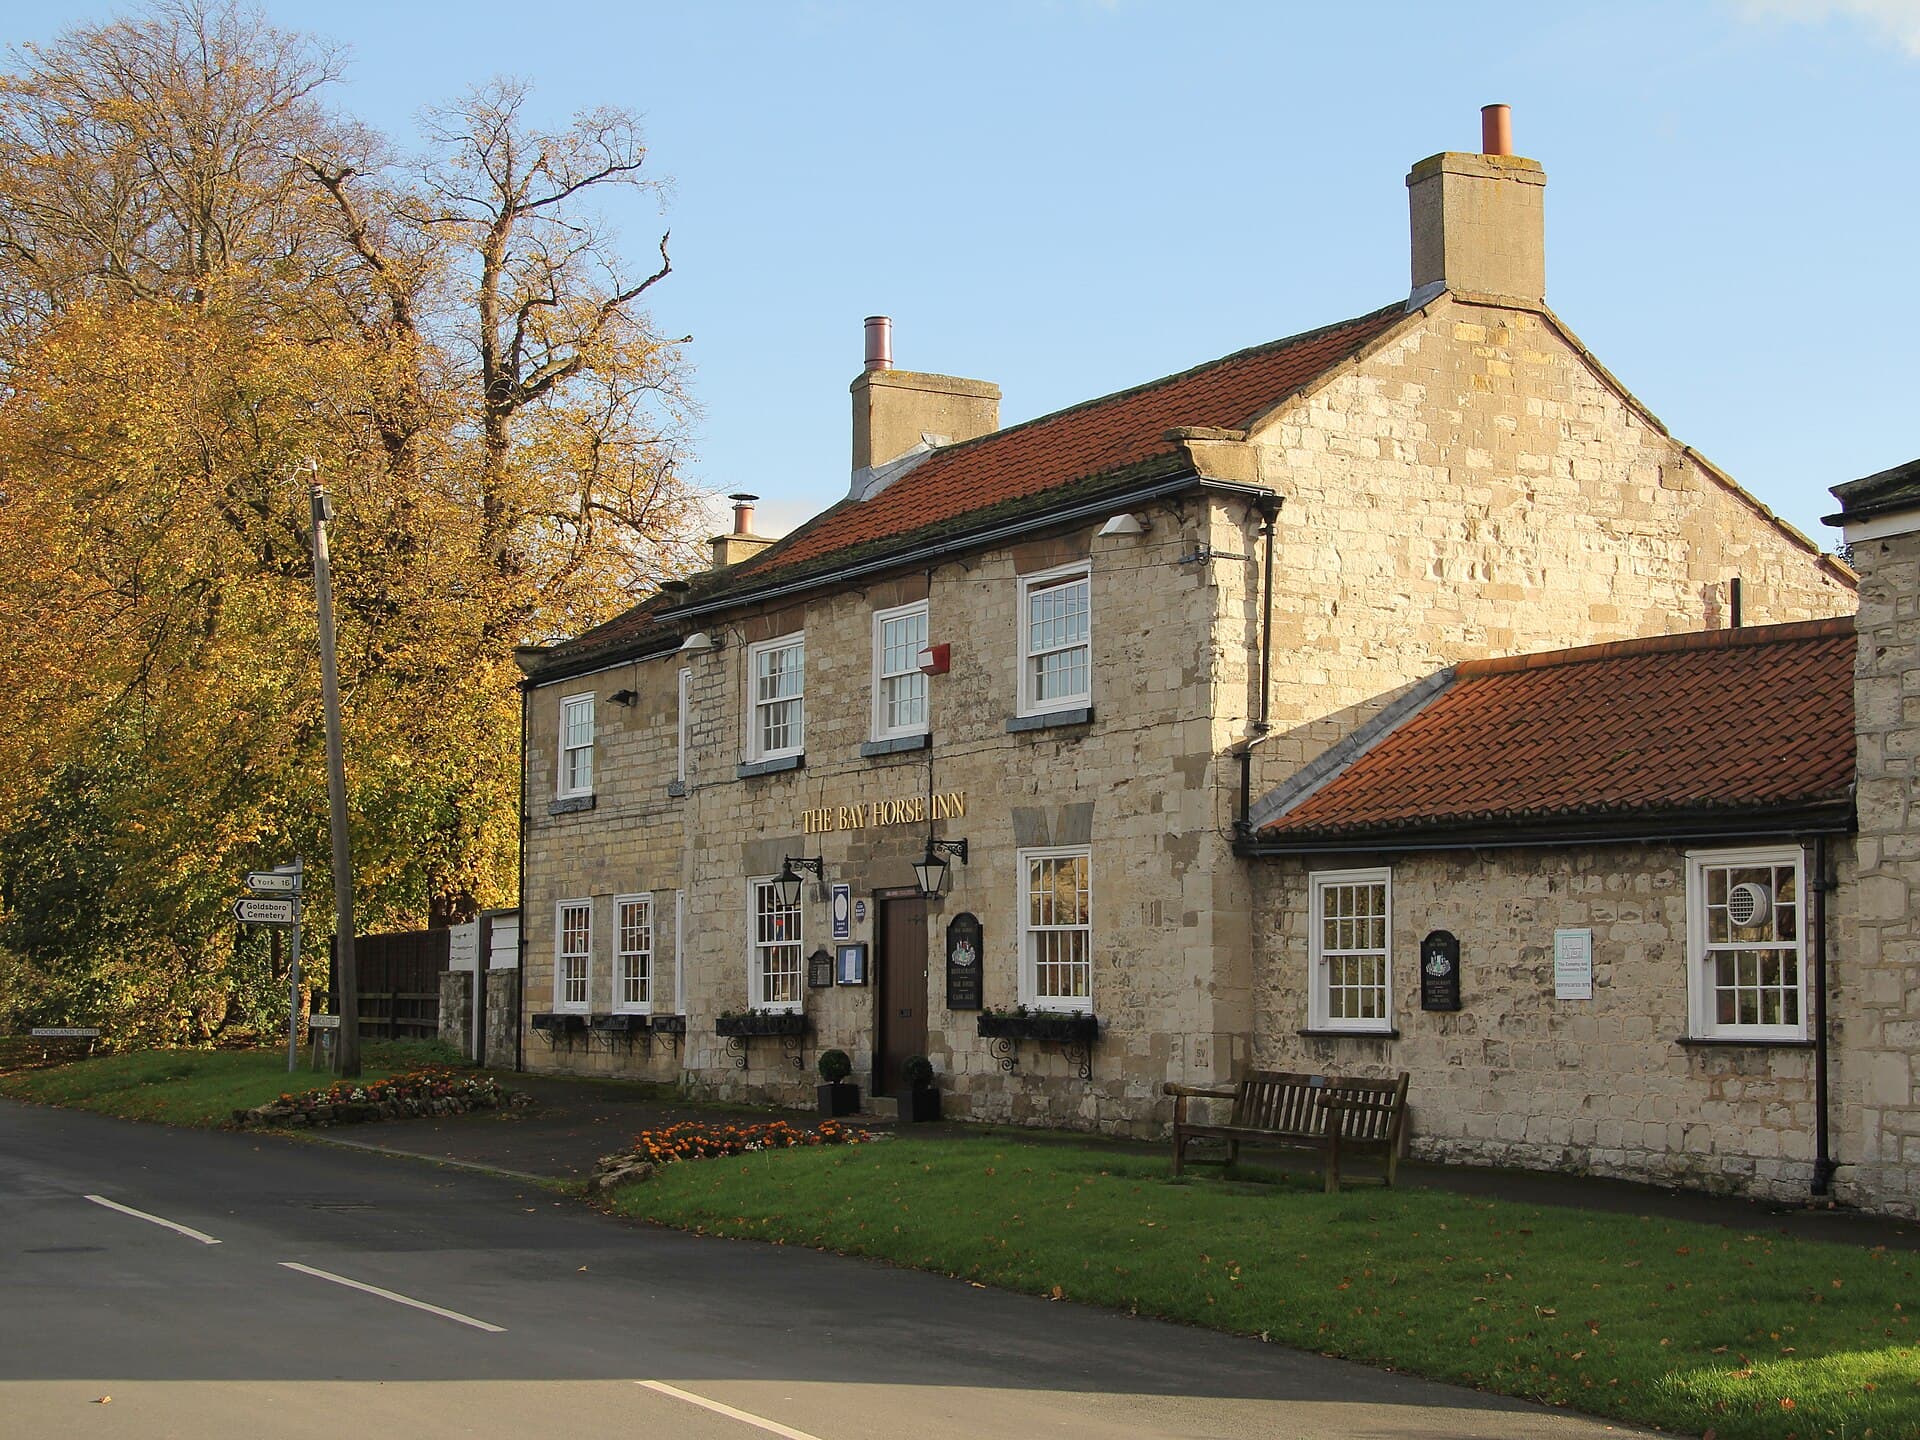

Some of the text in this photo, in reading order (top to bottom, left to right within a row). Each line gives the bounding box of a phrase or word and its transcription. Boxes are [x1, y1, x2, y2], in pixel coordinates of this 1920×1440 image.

[802, 791, 967, 834] THE BAY HORSE INN
[247, 911, 285, 920] Cemetery
